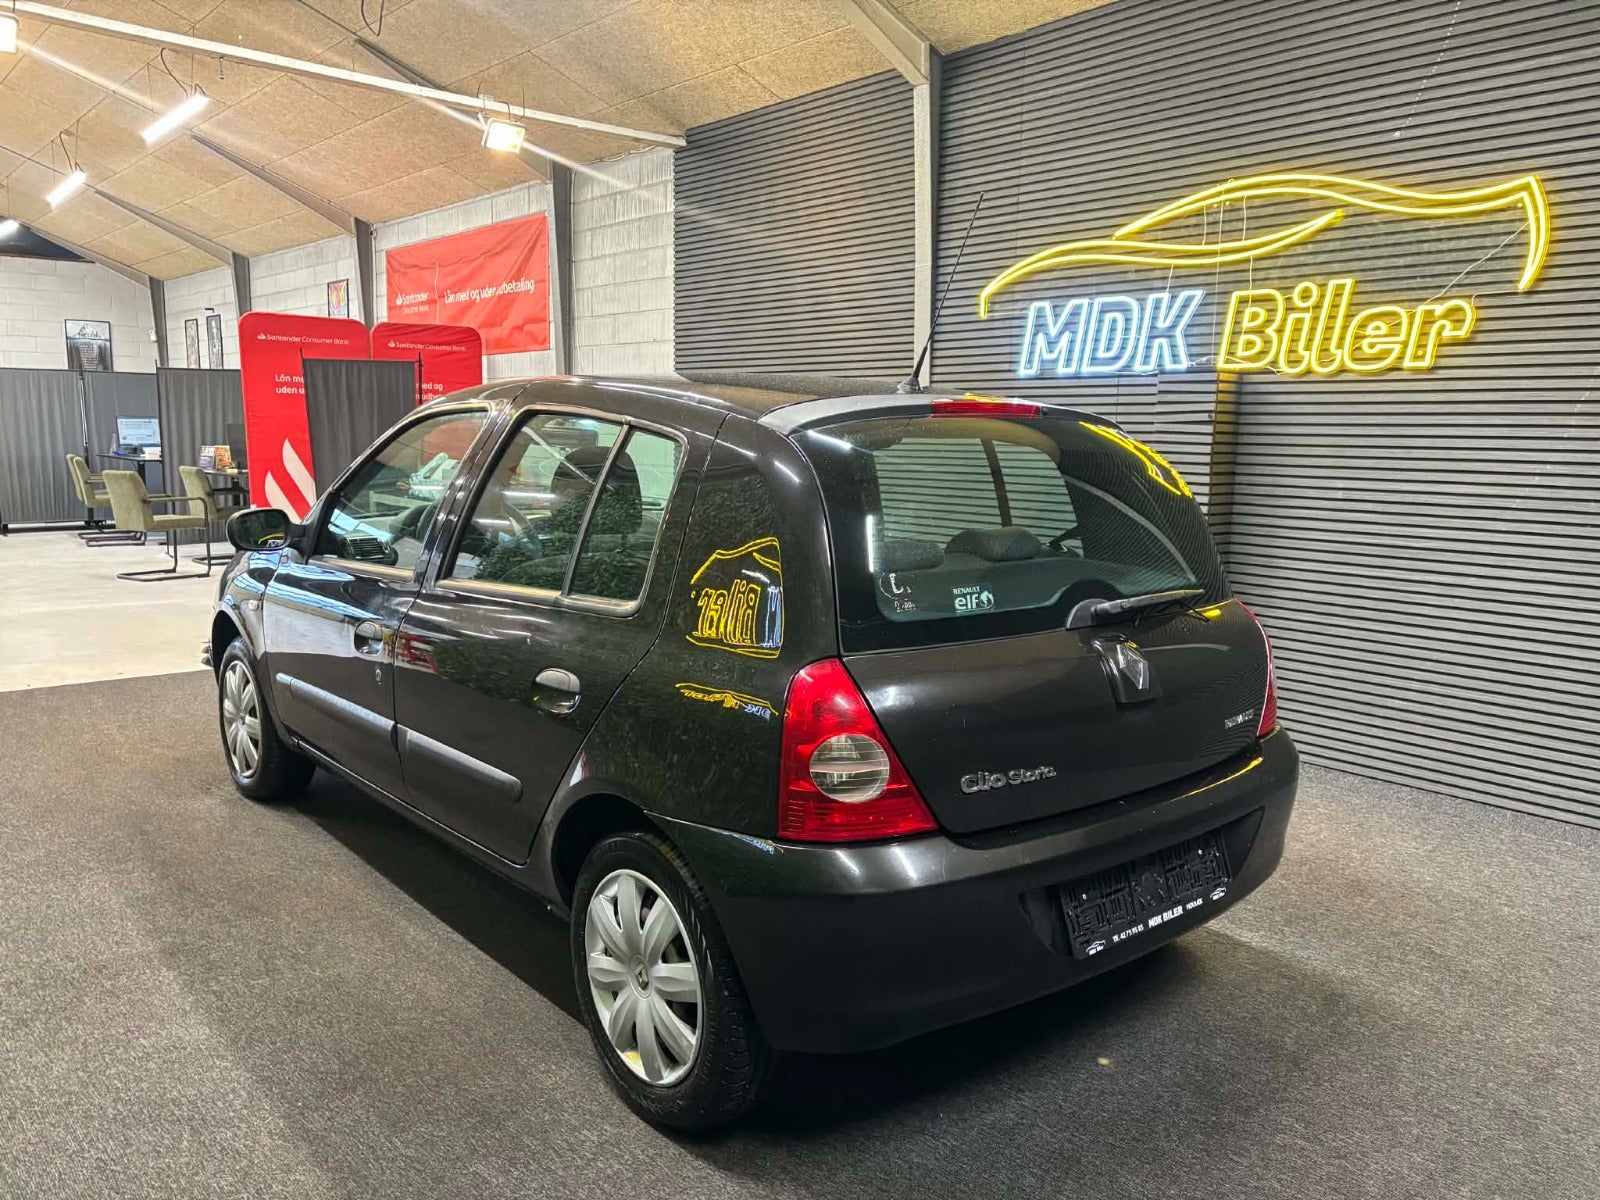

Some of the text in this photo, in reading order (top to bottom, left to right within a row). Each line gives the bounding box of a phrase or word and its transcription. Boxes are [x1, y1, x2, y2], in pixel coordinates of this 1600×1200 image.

[402, 291, 429, 305] Santander
[444, 289, 455, 304] Lån
[455, 288, 469, 303] med
[470, 289, 480, 303] og
[480, 284, 496, 299] uden
[1017, 277, 1477, 378] MDK Biler
[266, 333, 349, 346] Santander Consumer Bank
[396, 340, 466, 352] Santander Consumer Bank
[275, 373, 291, 383] Lån
[275, 385, 297, 395] uden
[433, 383, 443, 392] og
[952, 586, 980, 595] RENAULT
[954, 593, 980, 610] elf
[960, 766, 1057, 794] Clio Storia
[1148, 915, 1162, 928] MDK
[1163, 905, 1184, 921] BILER
